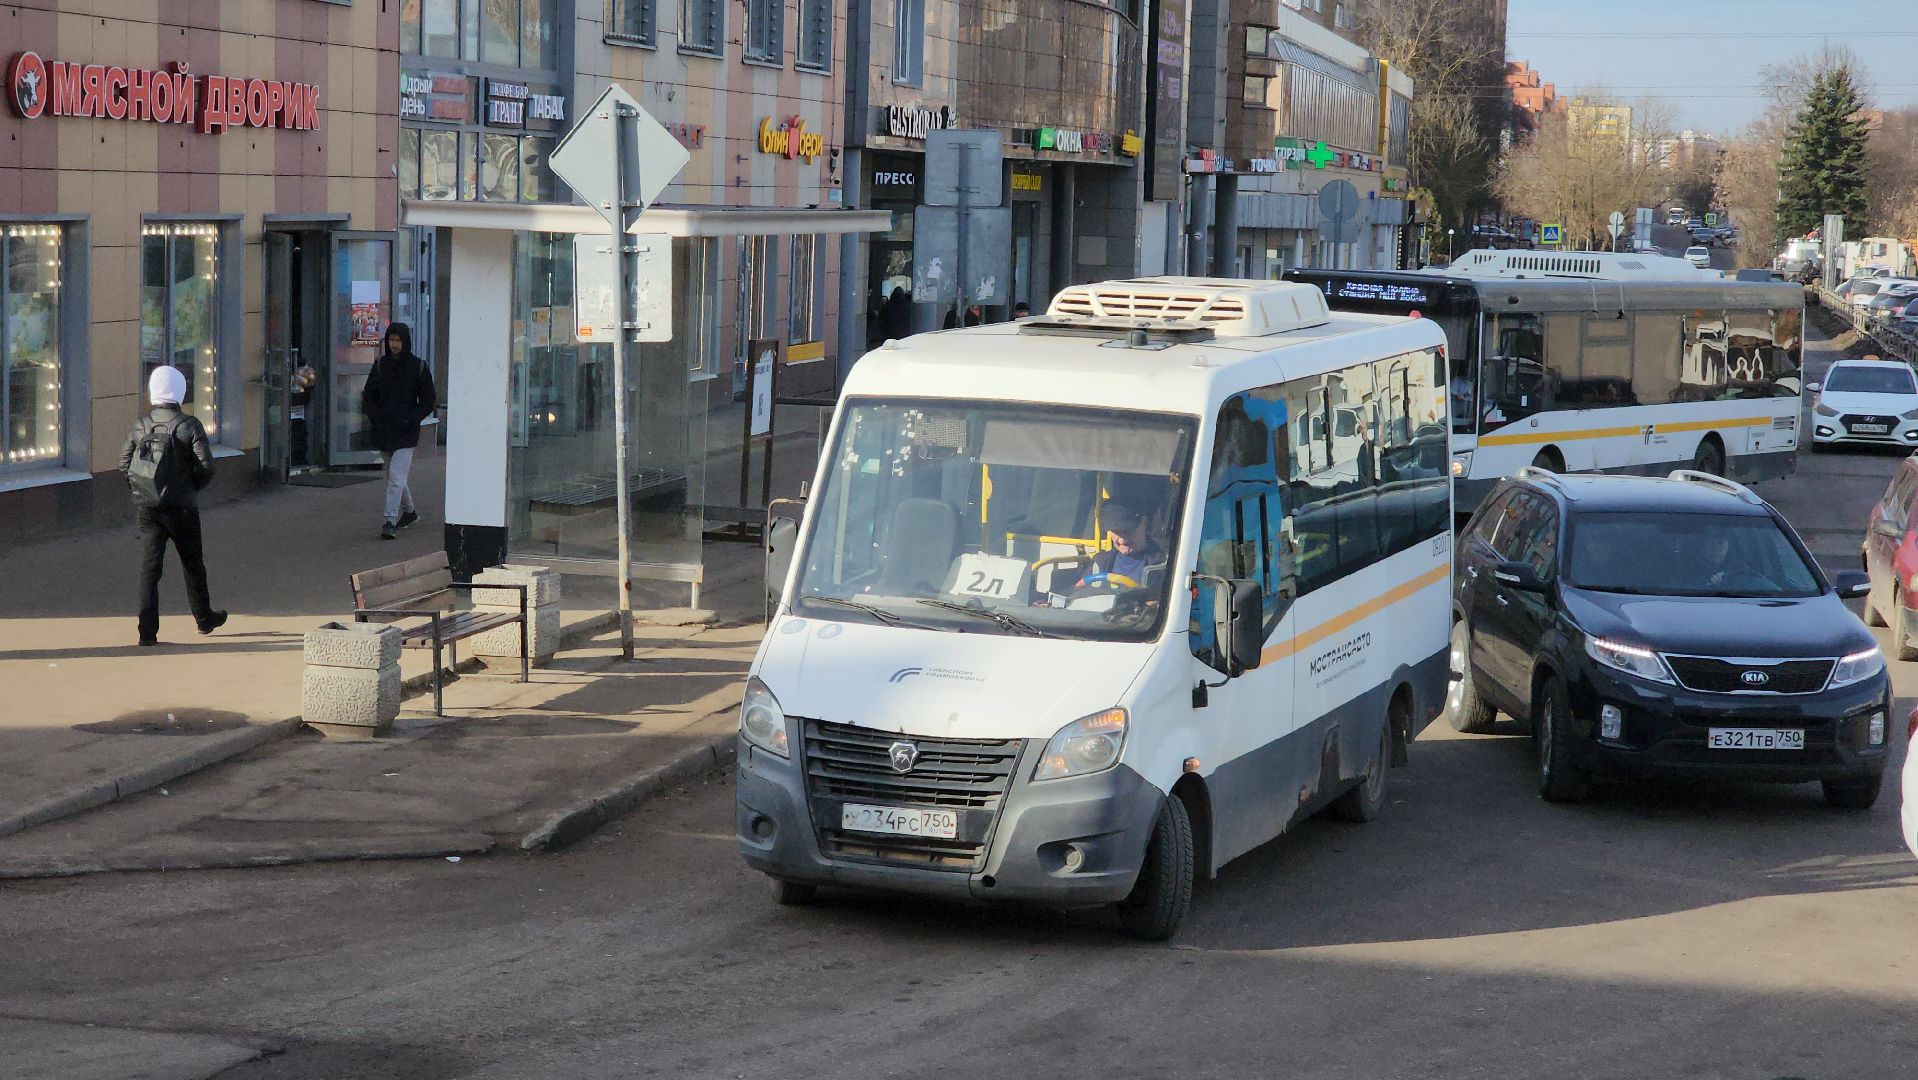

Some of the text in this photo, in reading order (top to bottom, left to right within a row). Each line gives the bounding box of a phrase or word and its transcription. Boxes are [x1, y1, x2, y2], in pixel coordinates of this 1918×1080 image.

[53, 61, 321, 134] МЯСНОЙ ДВОРИК
[494, 82, 529, 99] КАФЕ БАР
[401, 97, 426, 116] день
[533, 94, 565, 120] ТАБАК
[1056, 130, 1082, 152] ОКНА
[875, 172, 915, 185] ПРЕСС
[1310, 631, 1371, 677] МОСТРАНСАВТО
[1745, 674, 1765, 682] KIA
[1714, 731, 1800, 747] Е321ТВ 750
[922, 813, 950, 828] 750
